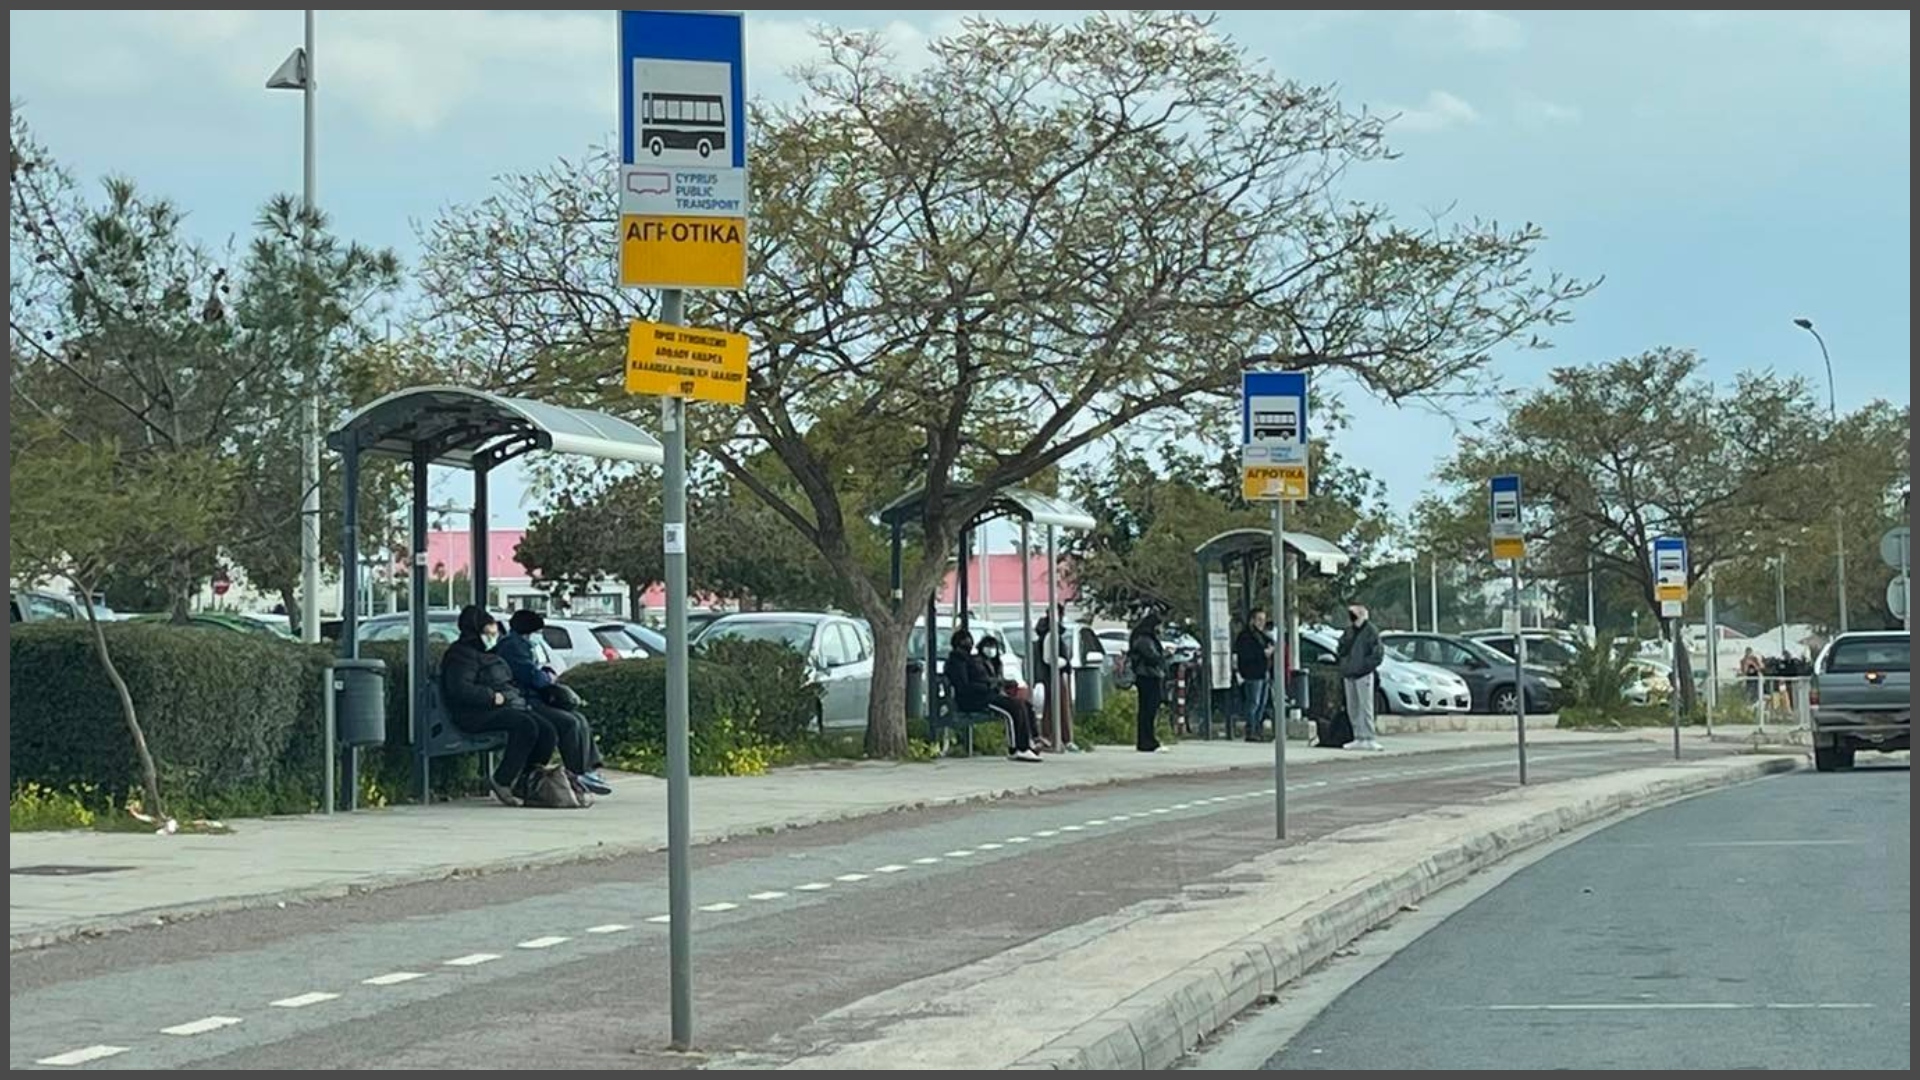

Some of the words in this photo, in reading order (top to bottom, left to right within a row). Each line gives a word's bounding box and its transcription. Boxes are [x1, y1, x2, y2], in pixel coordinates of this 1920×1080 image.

[675, 172, 718, 184] CYPRUS
[675, 185, 714, 197] PUBLIC
[675, 198, 740, 210] TRANSPORT
[1246, 468, 1305, 479] ΑΓΡΟΤΙΚΑ
